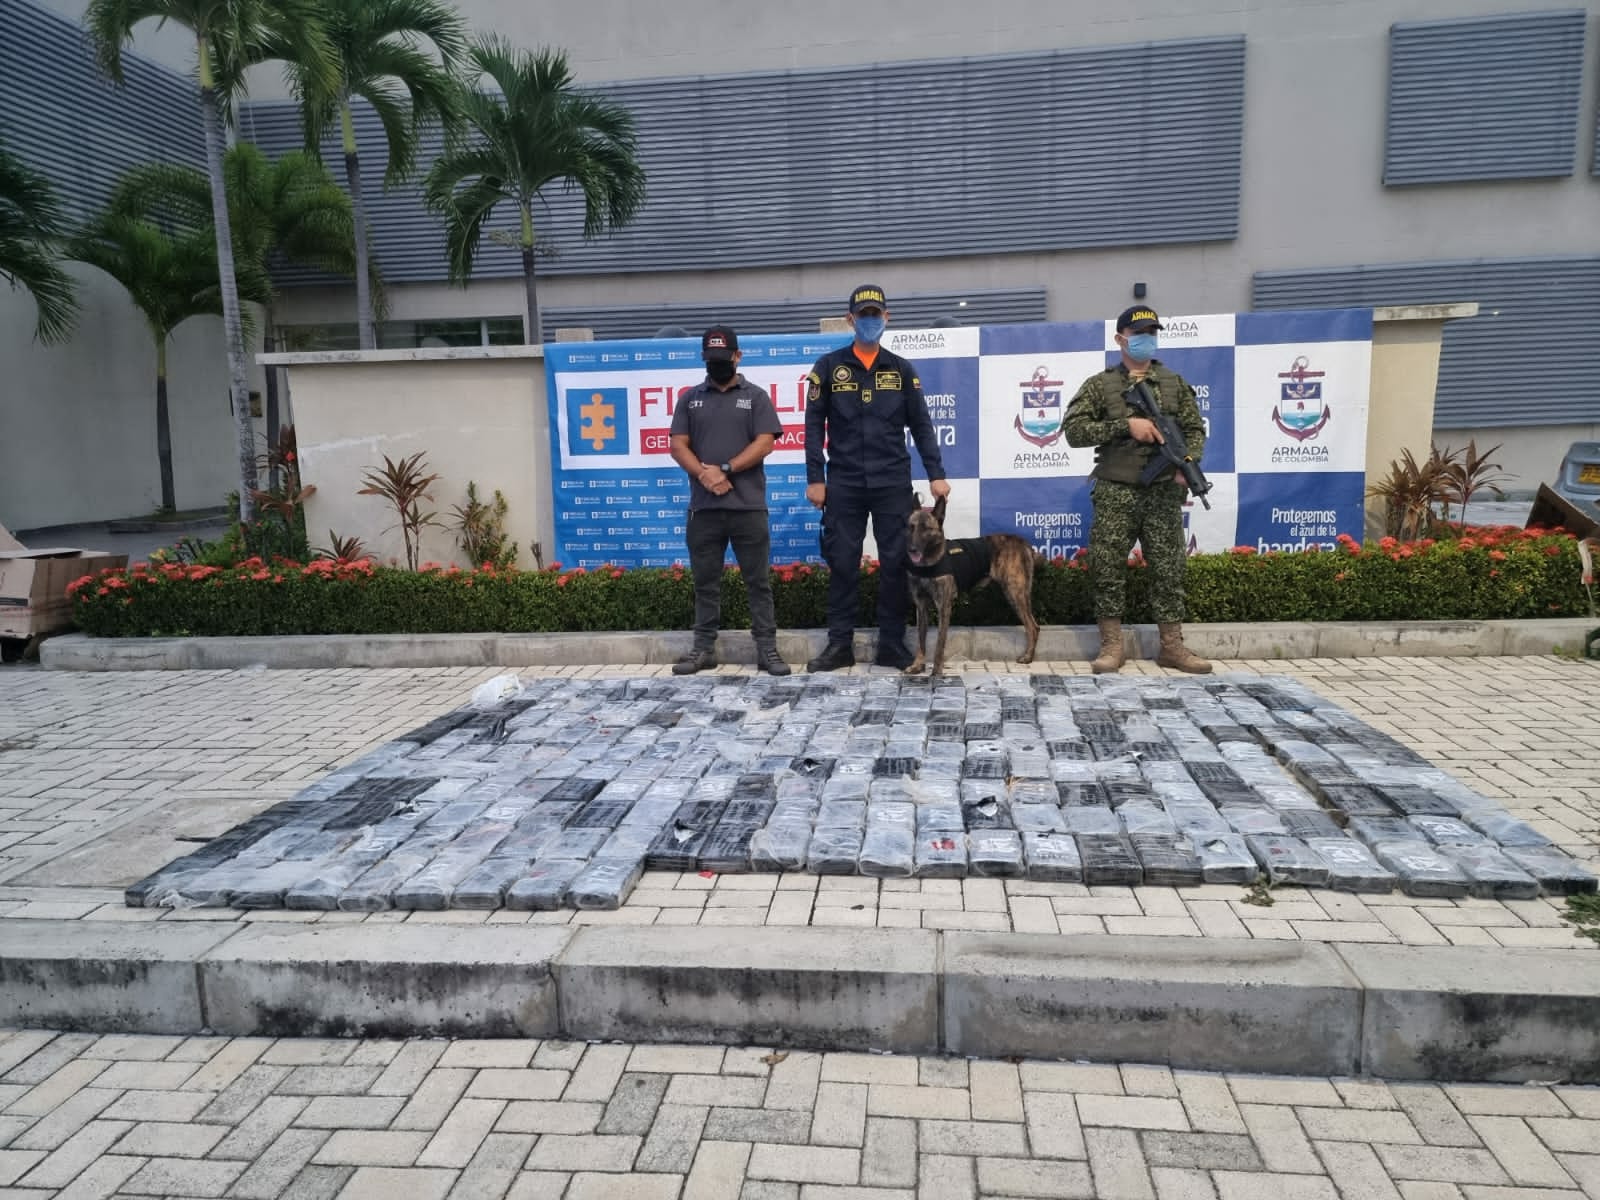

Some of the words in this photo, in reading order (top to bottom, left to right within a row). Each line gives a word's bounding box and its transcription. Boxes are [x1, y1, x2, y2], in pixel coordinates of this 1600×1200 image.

[892, 333, 945, 344] ARMADA
[904, 342, 945, 350] COLOMBIA
[1202, 399, 1210, 411] la
[937, 408, 947, 419] de
[949, 408, 956, 419] la
[1272, 446, 1328, 456] ARMADA
[1014, 452, 1070, 462] ARMADA
[1026, 461, 1070, 469] COLOMBIA
[1016, 511, 1082, 528] Protegemos
[1272, 507, 1336, 527] Protegemos
[1034, 527, 1042, 539] el
[1044, 527, 1060, 539] azul
[1062, 527, 1072, 538] de
[1074, 526, 1082, 538] la
[1290, 525, 1298, 537] el
[1299, 525, 1315, 537] azul
[1317, 525, 1327, 537] de
[1329, 525, 1336, 537] la
